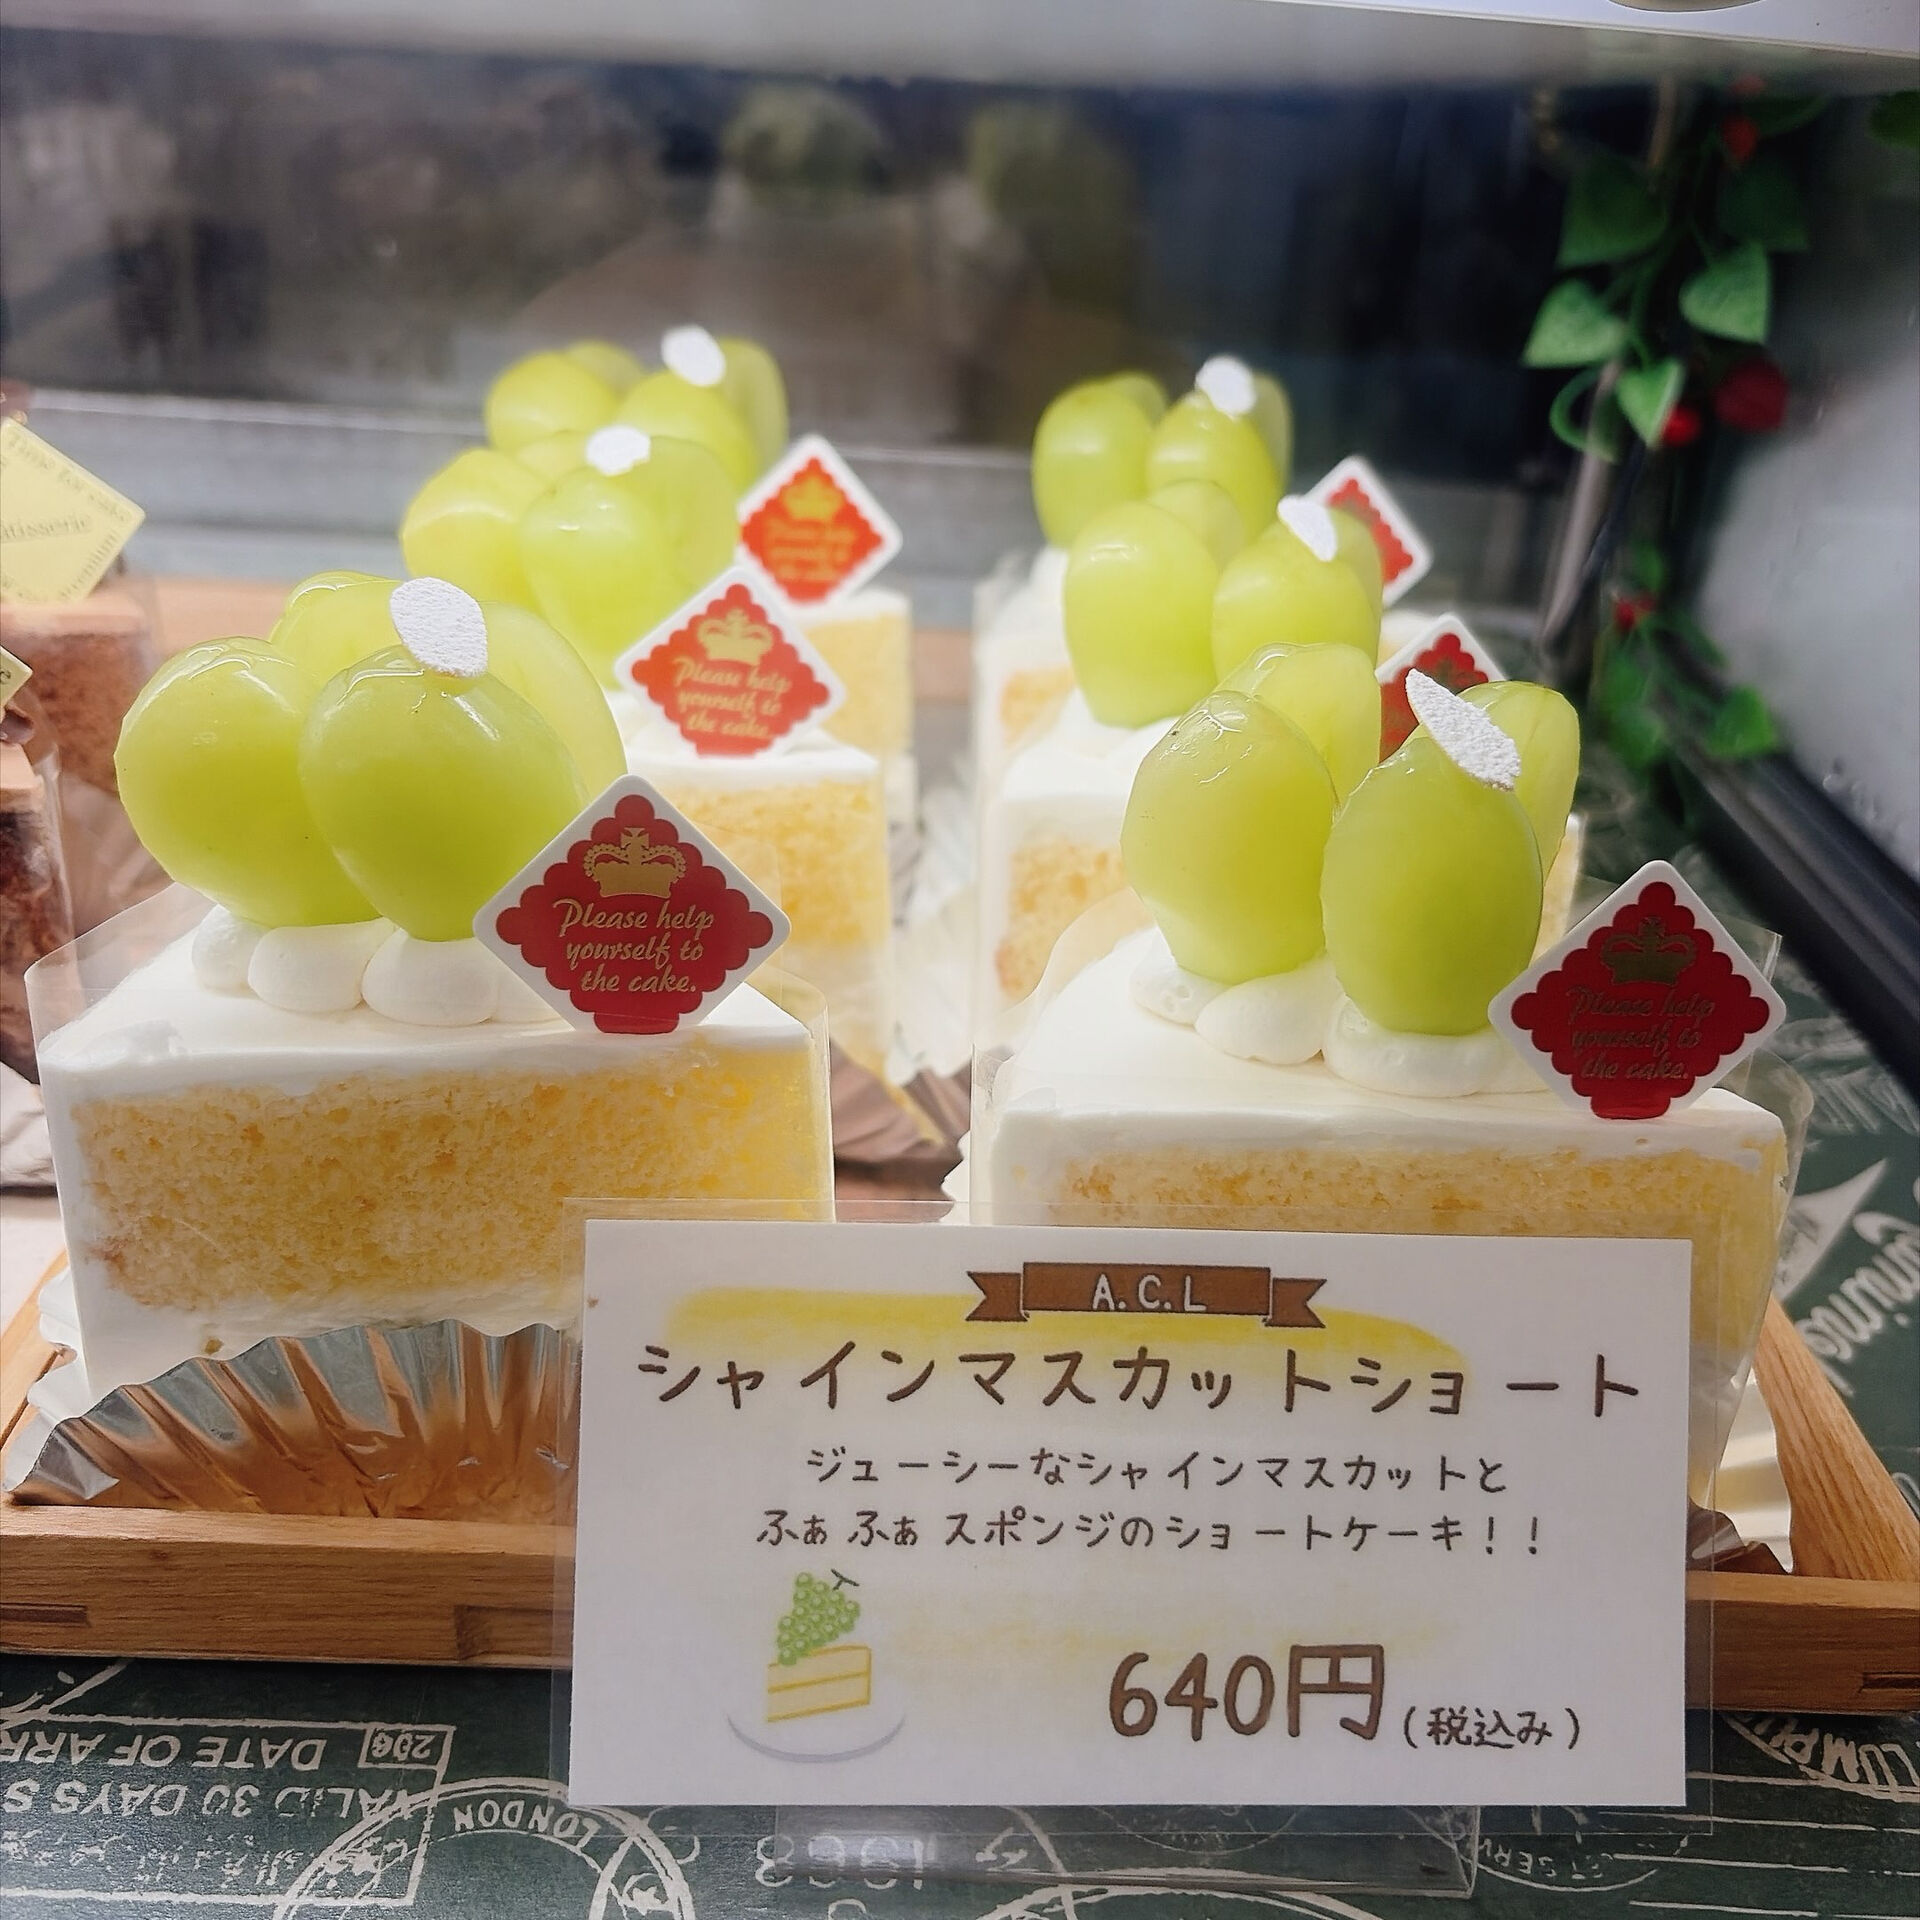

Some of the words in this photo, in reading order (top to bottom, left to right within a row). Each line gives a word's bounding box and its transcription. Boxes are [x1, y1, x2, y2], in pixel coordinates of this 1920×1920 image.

[553, 897, 648, 938] Please
[657, 900, 715, 940] help
[566, 932, 672, 970] yourself
[680, 940, 705, 962] to
[580, 963, 620, 992] the
[627, 966, 697, 993] cake.
[1566, 985, 1652, 1025] Please
[1659, 991, 1716, 1027] help
[1571, 1019, 1673, 1057] yourself
[1677, 1027, 1703, 1047] to
[1580, 1055, 1619, 1079] the
[1092, 1273, 1207, 1312] A.C.L
[637, 1340, 1640, 1418] シャインマスカットショート
[806, 1445, 1507, 1493] ジューシーなシャインマスカットと
[1109, 1643, 1385, 1742] 640円
[1403, 1706, 1581, 1750] （税込み）
[108, 1734, 181, 1768] OF
[191, 1736, 327, 1771] DATE
[51, 1779, 189, 1817] DAYS
[201, 1784, 260, 1818] 30
[452, 1799, 601, 1850] LONDON
